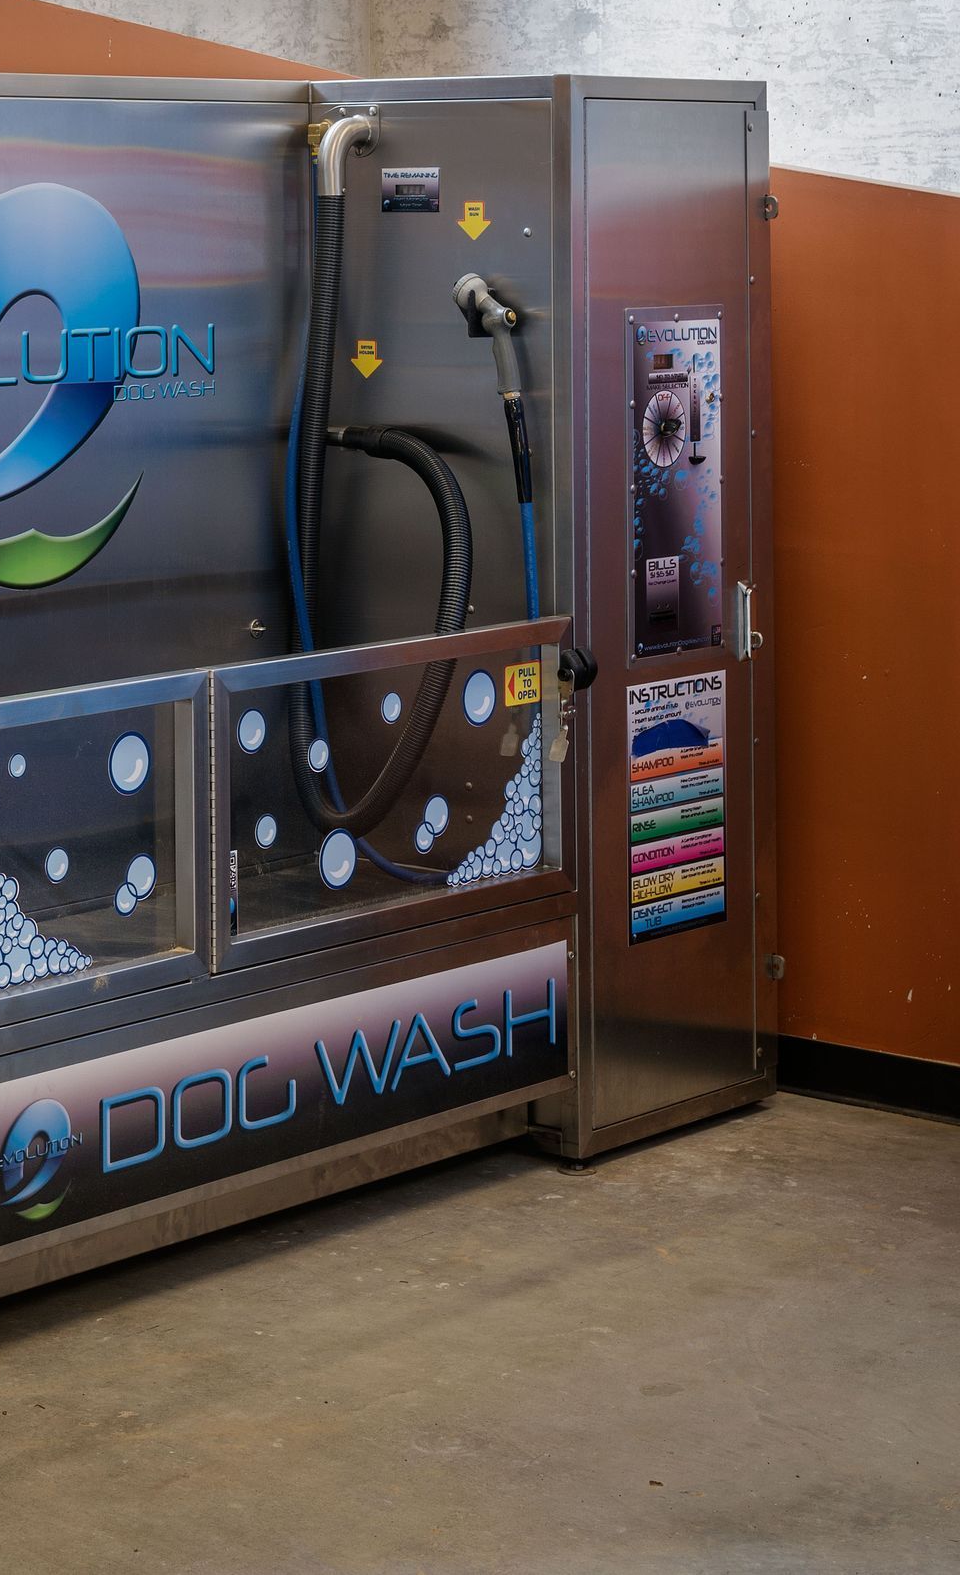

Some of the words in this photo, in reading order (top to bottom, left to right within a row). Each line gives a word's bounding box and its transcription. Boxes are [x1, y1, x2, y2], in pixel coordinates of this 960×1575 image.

[647, 327, 717, 343] EVOLUTION
[113, 385, 156, 402] DOG
[159, 380, 217, 400] WASH
[658, 394, 671, 402] OFF
[649, 559, 677, 571] BILLS
[656, 570, 665, 578] $5
[665, 569, 675, 577] $10
[518, 667, 537, 678] PULL
[523, 679, 532, 688] TO
[629, 675, 722, 705] INSTRUCTIONS
[517, 689, 537, 700] OPEN
[665, 711, 682, 719] amount
[632, 756, 674, 773] SHAMPOO
[632, 784, 655, 797] FLEA
[632, 791, 675, 809] SHAMPOO
[632, 820, 656, 833] RINSE
[632, 846, 675, 864] CONDITION
[632, 875, 657, 890] BLOW
[658, 871, 675, 883] DRY
[633, 901, 673, 920] DISINFECT
[645, 916, 661, 928] TUB
[99, 1055, 297, 1174] DOG
[314, 977, 557, 1107] WASH
